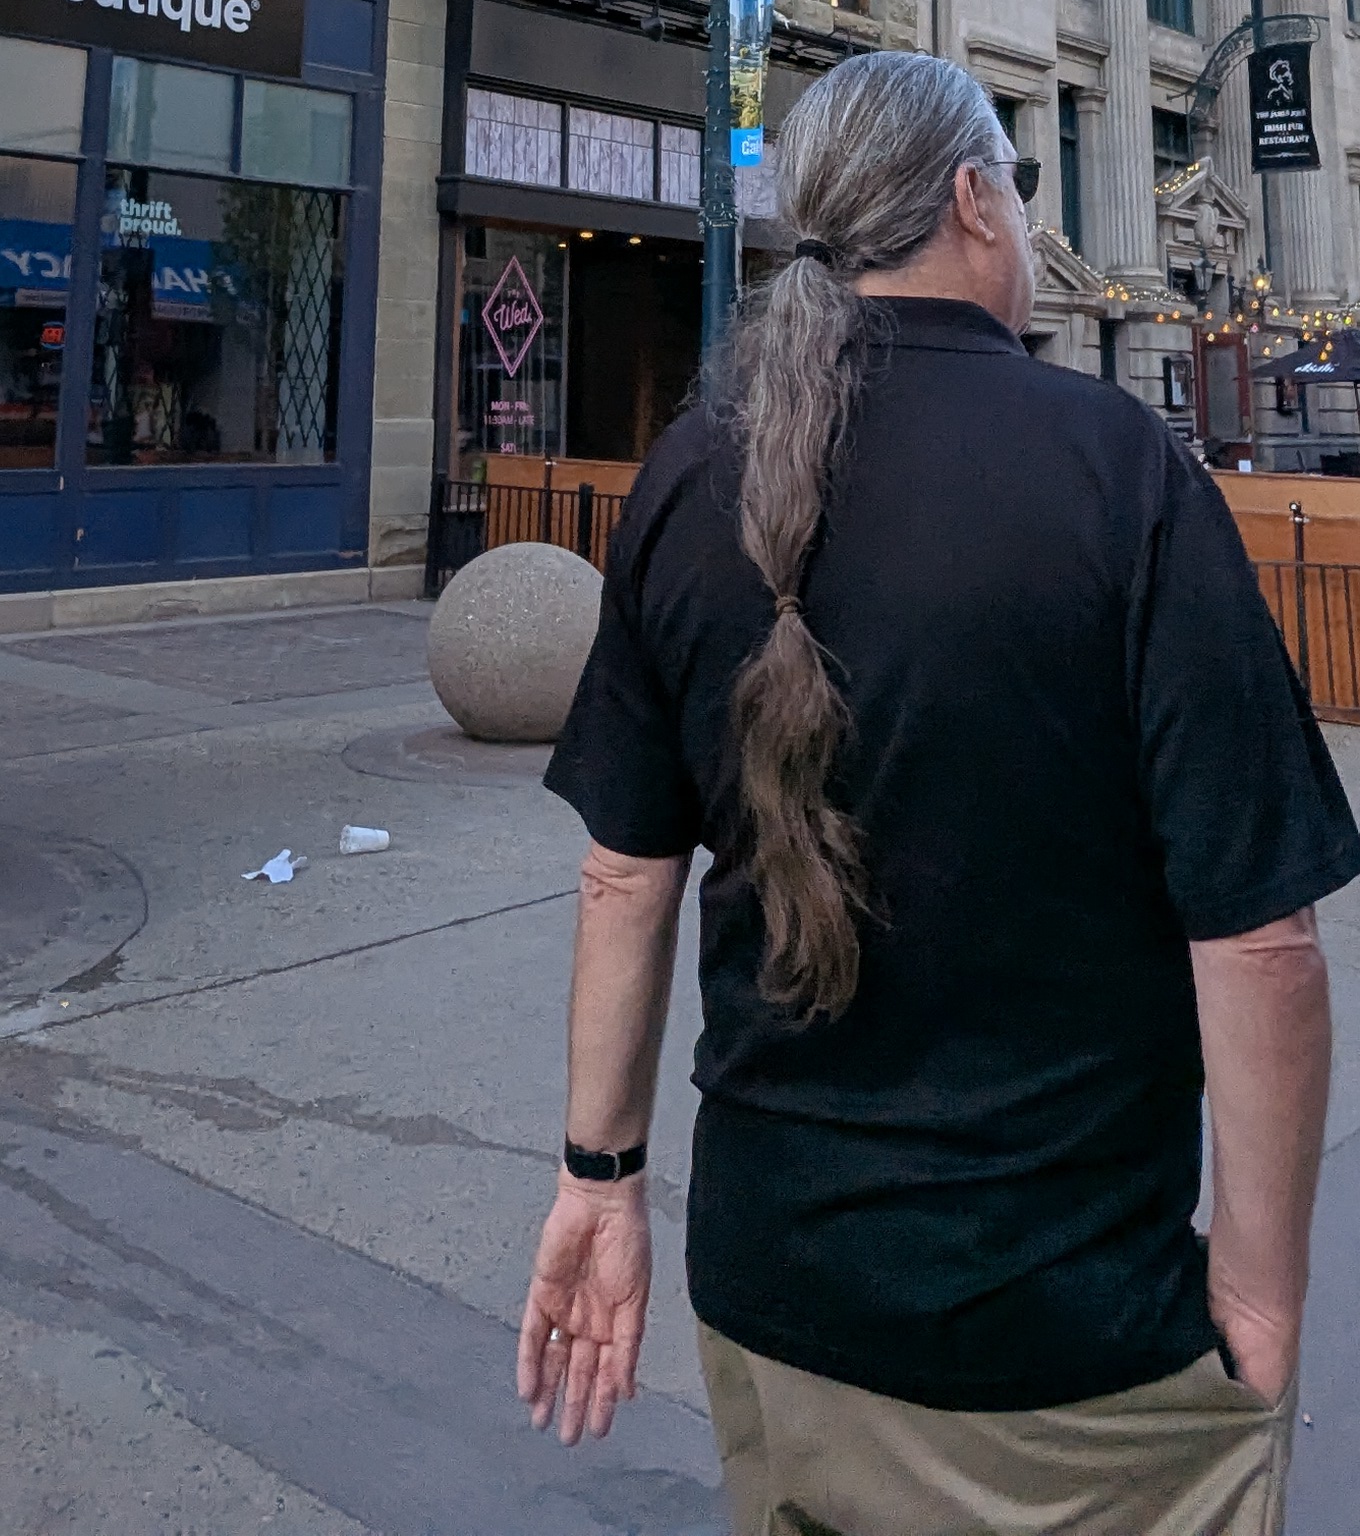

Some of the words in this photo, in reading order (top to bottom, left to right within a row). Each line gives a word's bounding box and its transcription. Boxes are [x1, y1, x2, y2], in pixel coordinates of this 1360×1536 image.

[1258, 134, 1310, 146] RESTAURANT
[120, 198, 173, 220] thrift
[119, 217, 182, 236] proud.
